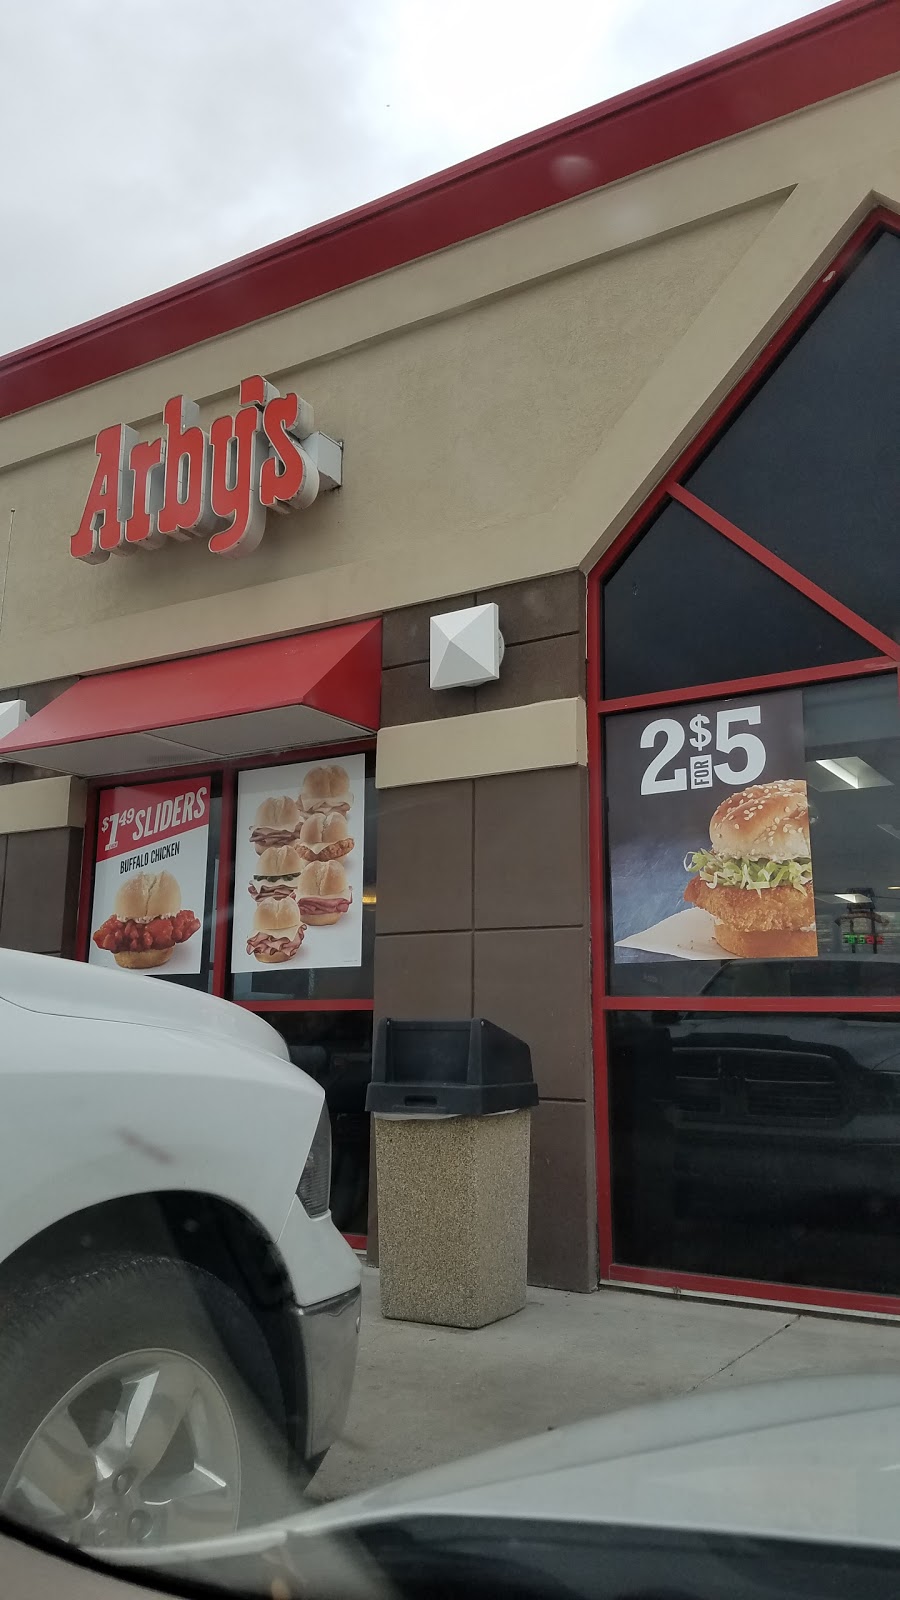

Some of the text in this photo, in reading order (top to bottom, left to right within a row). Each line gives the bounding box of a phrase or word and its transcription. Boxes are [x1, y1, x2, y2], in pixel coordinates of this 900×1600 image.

[70, 374, 310, 558] Arby's
[640, 718, 688, 796] 2
[693, 759, 710, 786] FOR
[132, 786, 208, 841] SLIDERS
[119, 841, 181, 875] BUFFALO CHICKEN
